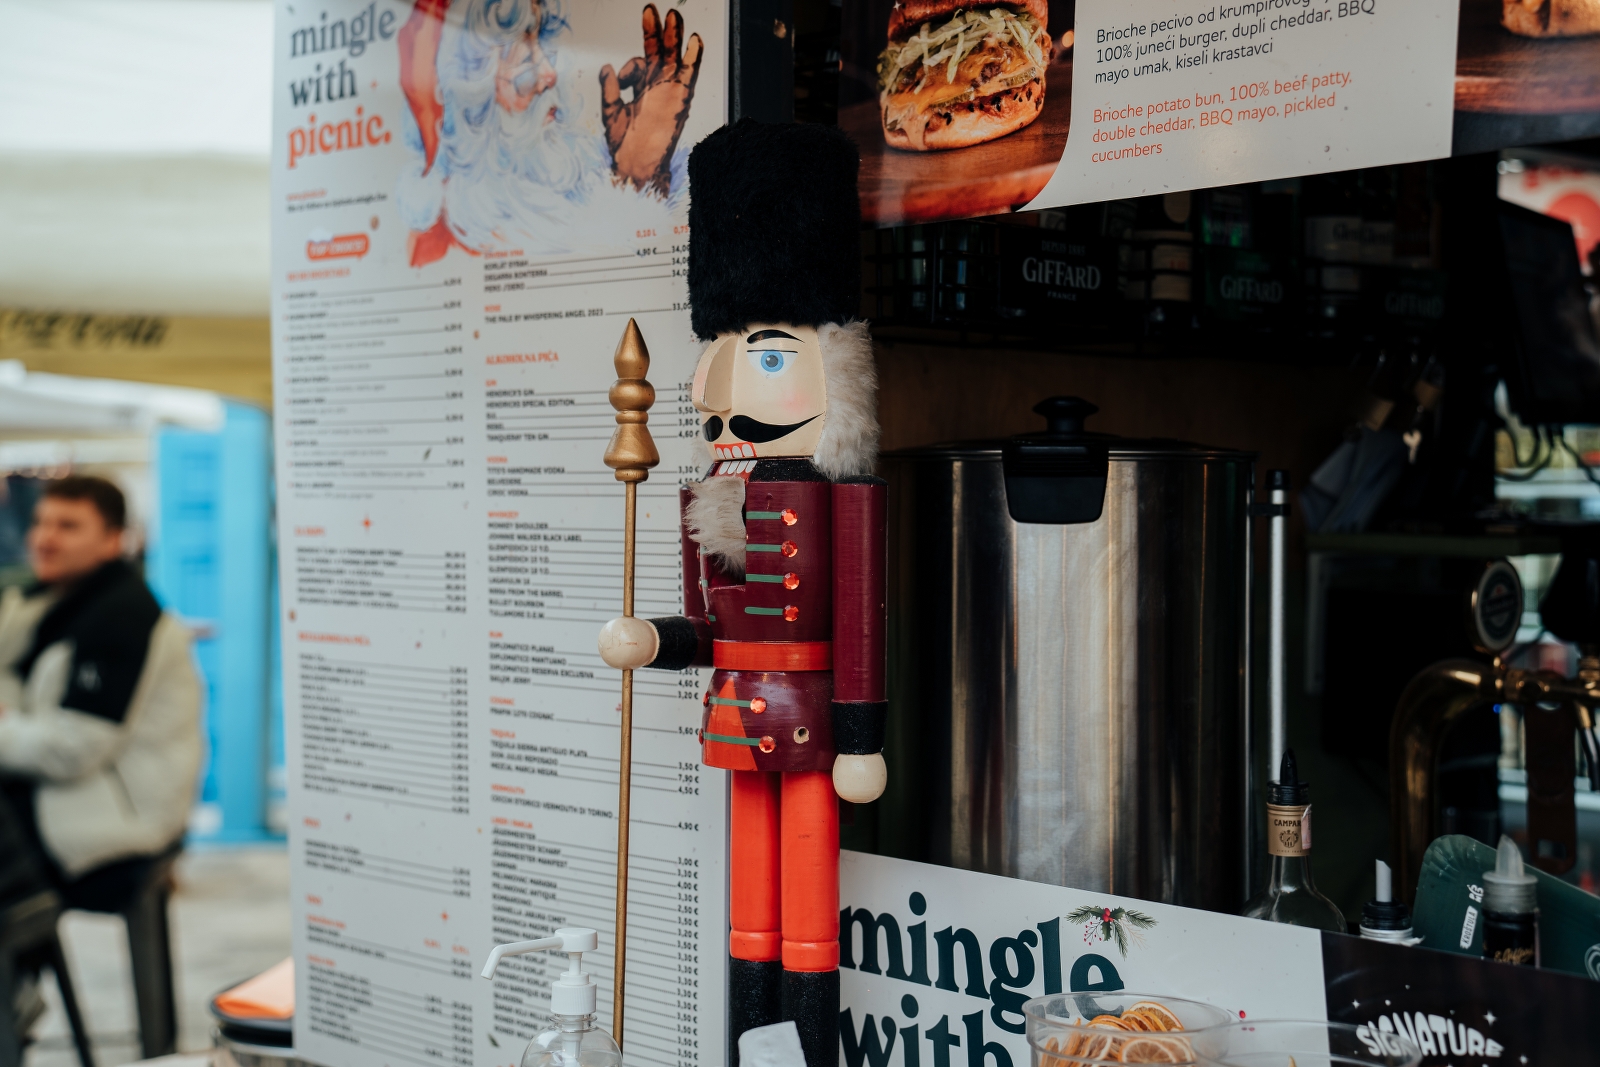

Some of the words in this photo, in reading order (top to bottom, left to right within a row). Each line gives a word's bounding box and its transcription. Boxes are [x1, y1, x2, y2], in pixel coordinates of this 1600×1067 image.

[291, 1, 396, 58] mingle
[1096, 23, 1146, 43] Brioche
[1151, 14, 1193, 37] pecivo
[1198, 7, 1215, 24] od
[1096, 44, 1132, 63] 100%
[1135, 35, 1175, 60] juneći
[1180, 30, 1227, 48] burger,
[1232, 18, 1266, 39] dupli
[1270, 8, 1332, 31] cheddar,
[1338, 0, 1375, 18] BBQ
[1095, 68, 1130, 85] mayo
[1133, 58, 1171, 78] umak,
[1176, 50, 1208, 69] kiseli
[1213, 38, 1273, 63] krastavci
[290, 59, 358, 107] with
[1093, 104, 1143, 123] Brioche
[1147, 98, 1190, 118] potato
[1195, 93, 1224, 107] bun,
[1229, 81, 1270, 101] 100%
[1274, 75, 1308, 95] beef
[1312, 71, 1352, 92] patty,
[1092, 125, 1136, 142] double
[1139, 117, 1196, 136] cheddar,
[1199, 108, 1233, 127] BBQ
[1237, 106, 1280, 123] mayo,
[1284, 92, 1336, 118] pickled
[287, 106, 392, 168] picnic.
[1091, 143, 1163, 163] cucumbers
[636, 230, 651, 239] 0,10
[1021, 256, 1102, 291] GIFFARD
[1220, 274, 1284, 304] GIFFARD
[523, 311, 563, 320] WHISPERING
[565, 310, 585, 318] ANGEL
[548, 398, 575, 407] EDITION
[678, 407, 694, 415] 5,50
[678, 418, 694, 427] 3,80
[678, 430, 694, 439] 4,60
[678, 466, 694, 475] 3,30
[515, 522, 549, 530] SHOULDER
[543, 534, 562, 542] BLACK
[564, 534, 582, 543] LABEL
[532, 667, 559, 676] RESERVA
[560, 669, 594, 679] EXCLUSIVA
[678, 681, 693, 690] 4,60
[678, 692, 693, 701] 3,20
[694, 692, 699, 700] €
[679, 726, 693, 736] 5,60
[570, 749, 588, 758] PLATA
[678, 762, 693, 771] 3,50
[694, 763, 699, 771] €
[678, 774, 693, 783] 7,90
[694, 775, 699, 783] €
[678, 786, 693, 795] 4,50
[694, 787, 699, 795] €
[543, 801, 578, 813] VERMOUTH
[588, 808, 613, 819] TORINO
[678, 822, 693, 832] 4,90
[694, 823, 699, 831] €
[1273, 819, 1302, 827] CAMPAR
[678, 856, 692, 866] 3,00
[694, 859, 699, 867] €
[677, 868, 692, 878] 3,30
[693, 871, 698, 879] €
[677, 880, 692, 890] 4,00
[693, 883, 698, 891] €
[678, 892, 692, 902] 3,30
[678, 904, 692, 914] 2,50
[678, 916, 692, 926] 3,50
[678, 928, 692, 938] 3,20
[1461, 911, 1476, 945] KROŠTULA
[677, 940, 692, 950] 3,50
[678, 952, 692, 962] 3,30
[839, 891, 1125, 1034] mingle
[677, 1012, 691, 1022] 3,50
[839, 993, 1015, 1067] with
[1356, 1011, 1504, 1058] SIGNATURE
